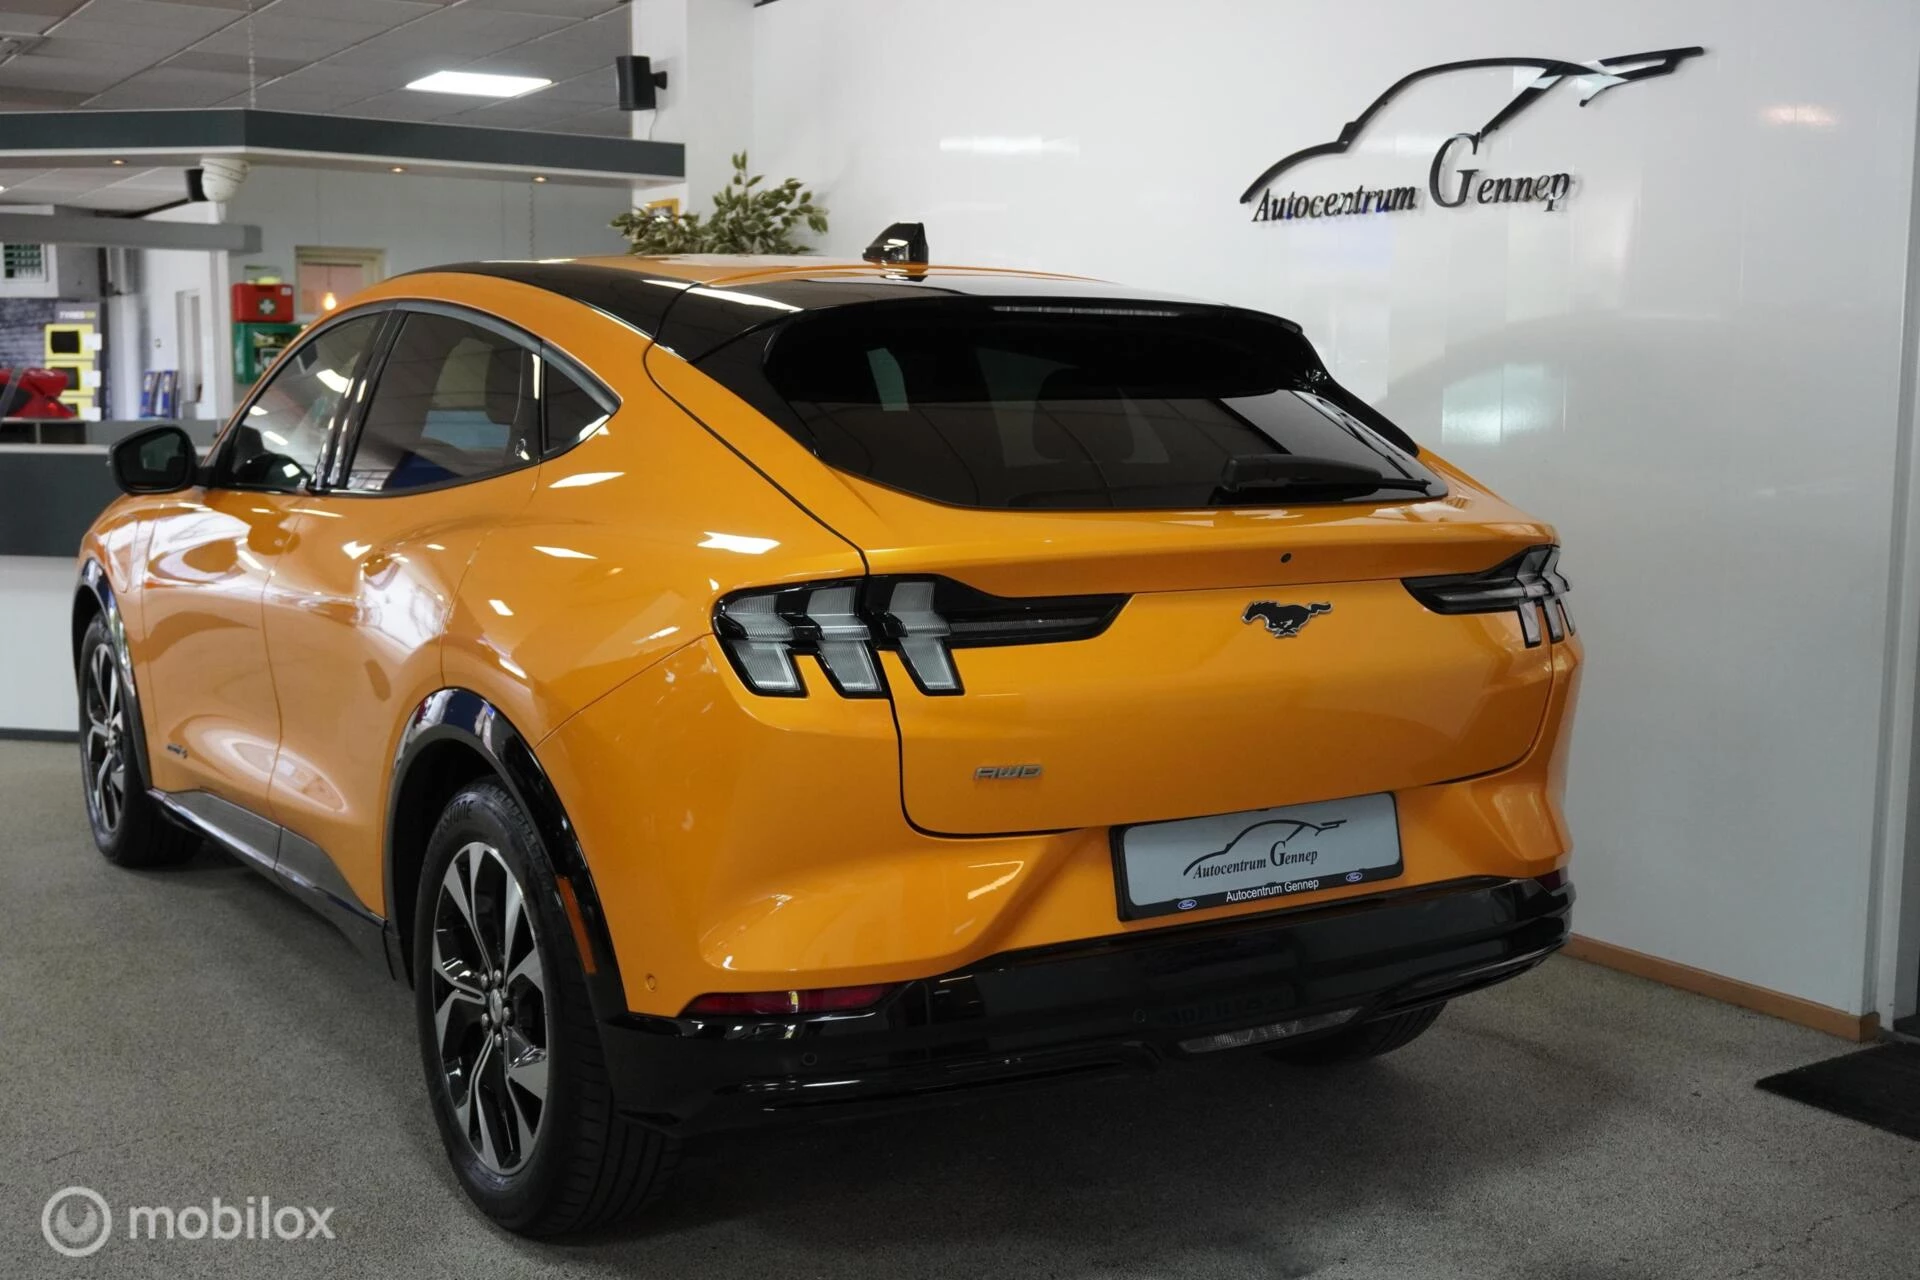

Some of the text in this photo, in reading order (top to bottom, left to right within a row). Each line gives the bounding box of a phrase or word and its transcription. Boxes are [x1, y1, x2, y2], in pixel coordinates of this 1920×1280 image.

[1252, 132, 1570, 222] Autocentrum Gennep
[975, 765, 1042, 779] AWD
[1193, 840, 1318, 880] Autocentrum Gennep
[1226, 880, 1319, 902] Autocentrum Gennep
